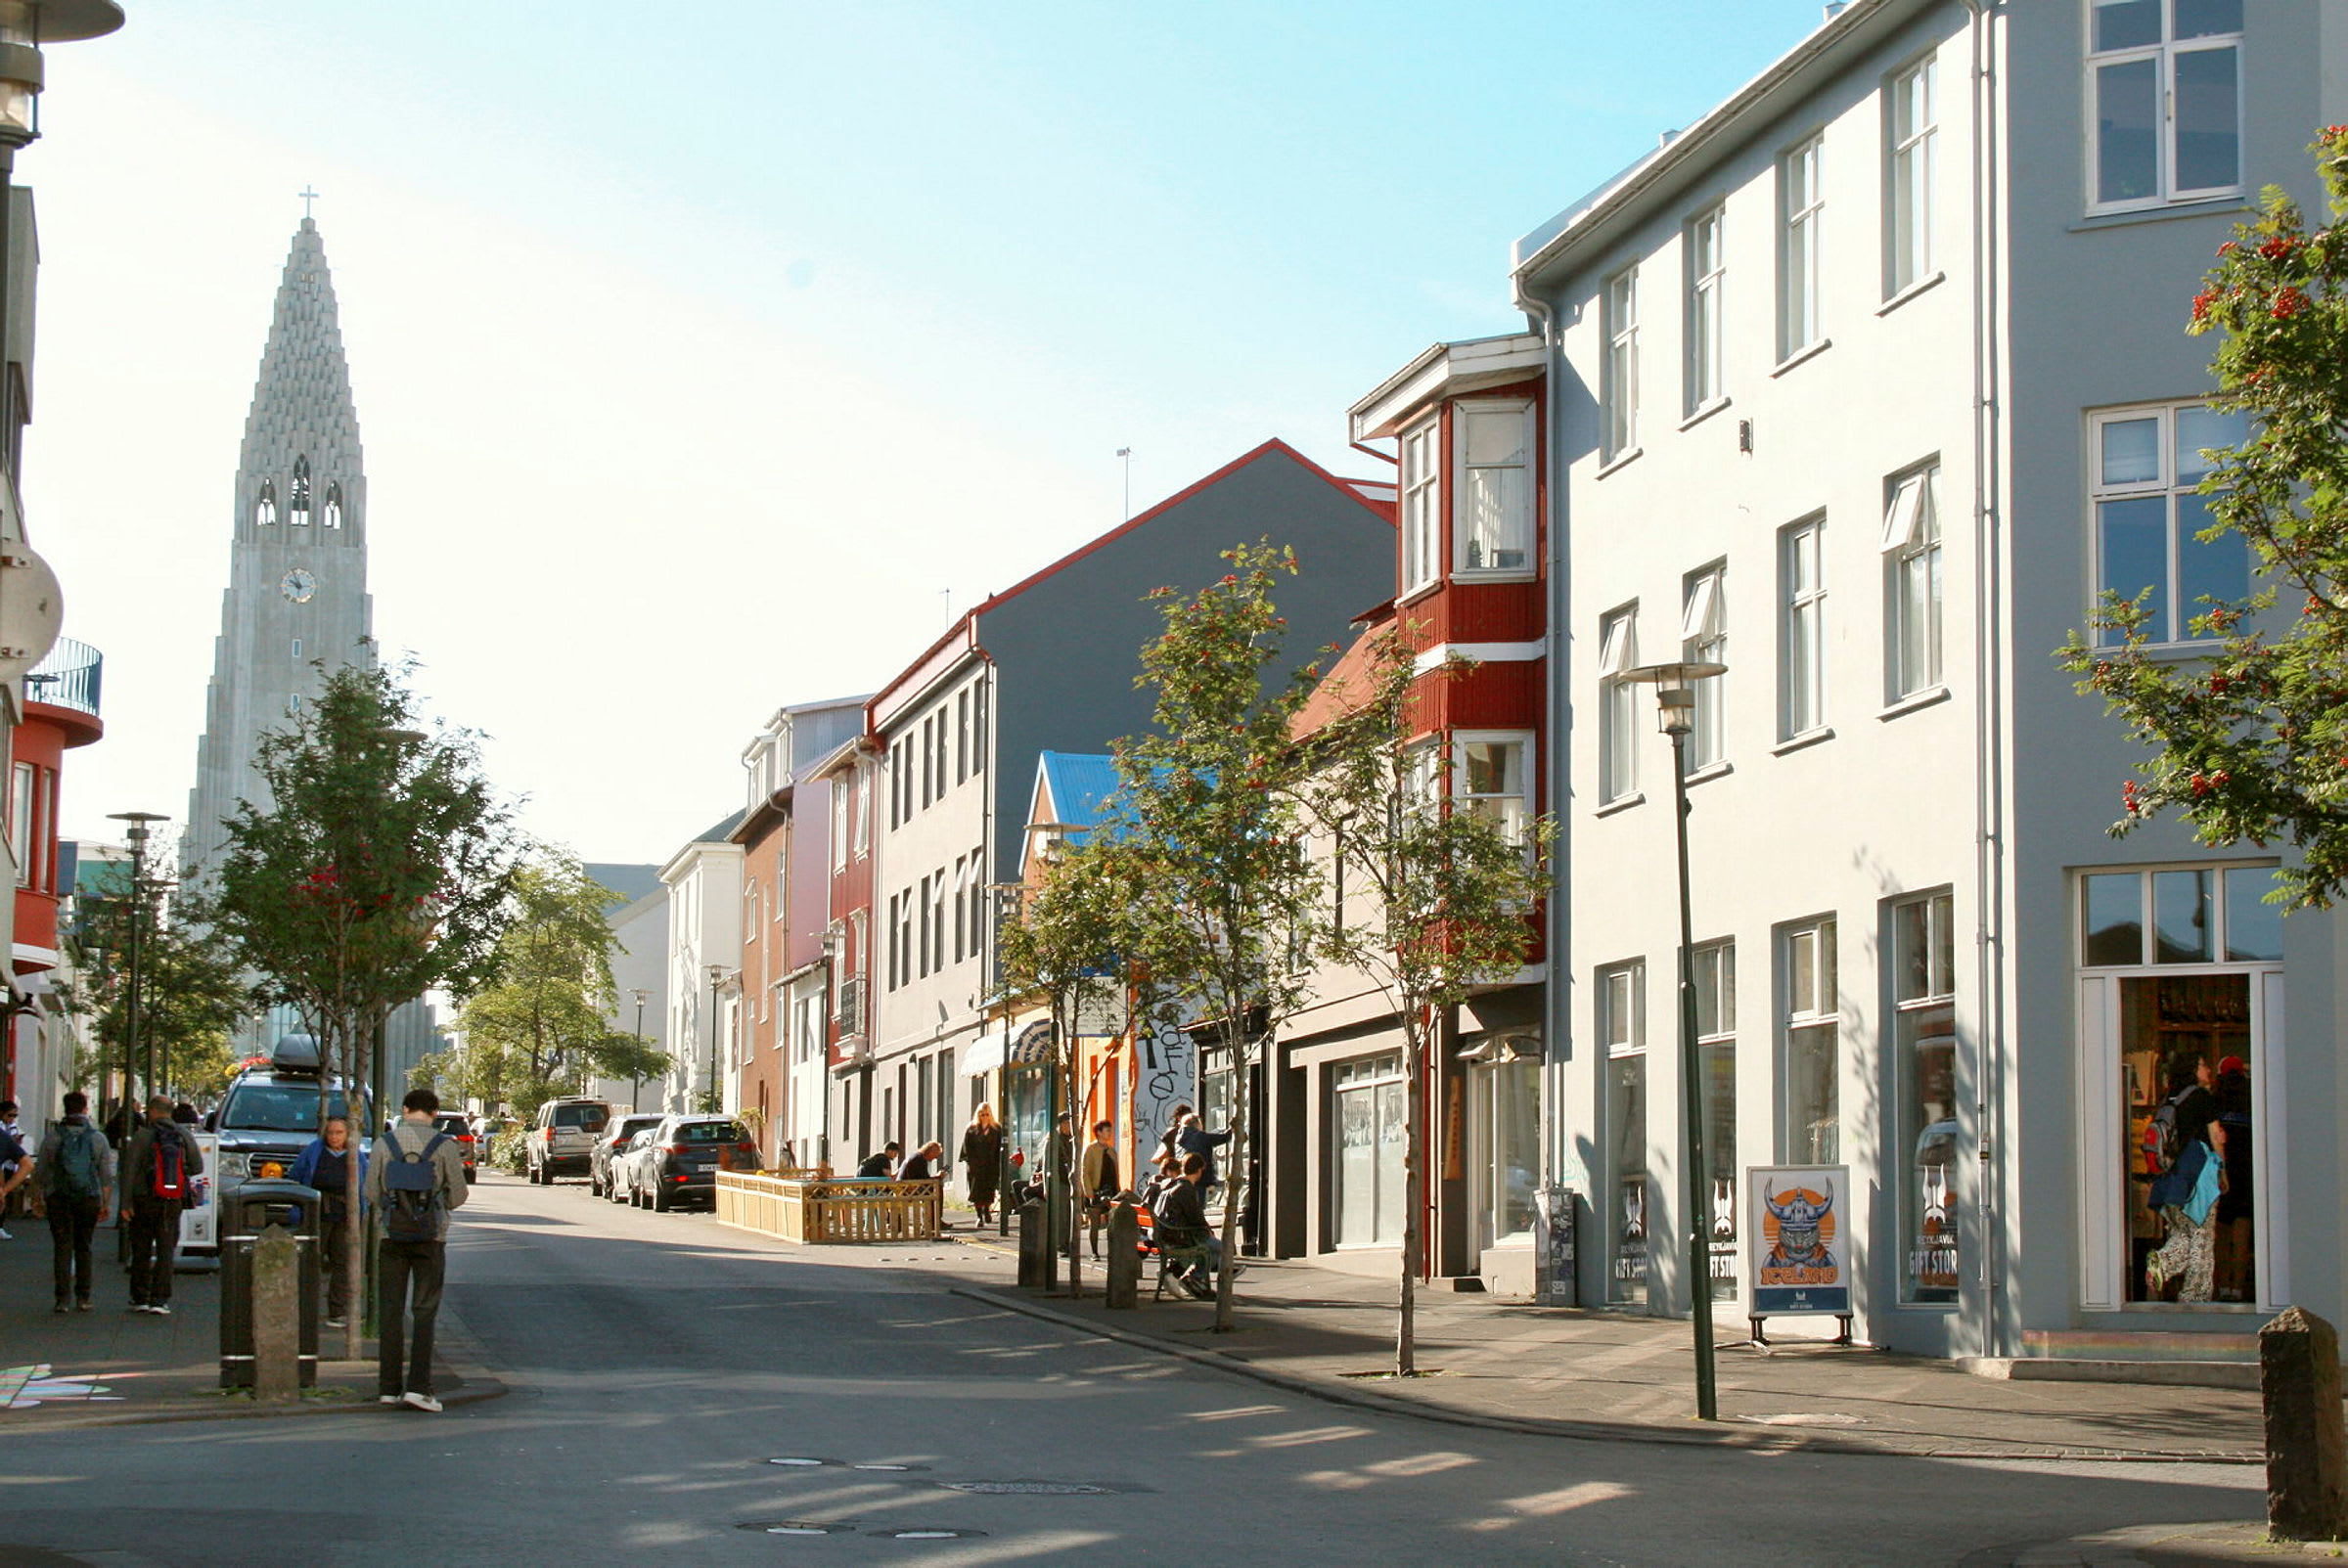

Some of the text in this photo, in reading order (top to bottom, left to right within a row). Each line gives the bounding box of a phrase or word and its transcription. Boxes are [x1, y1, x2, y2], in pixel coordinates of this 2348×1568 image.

[1709, 1255, 1738, 1277] FT STO
[1909, 1249, 1958, 1276] GIFT STOR
[1760, 1267, 1838, 1285] ICELAND
